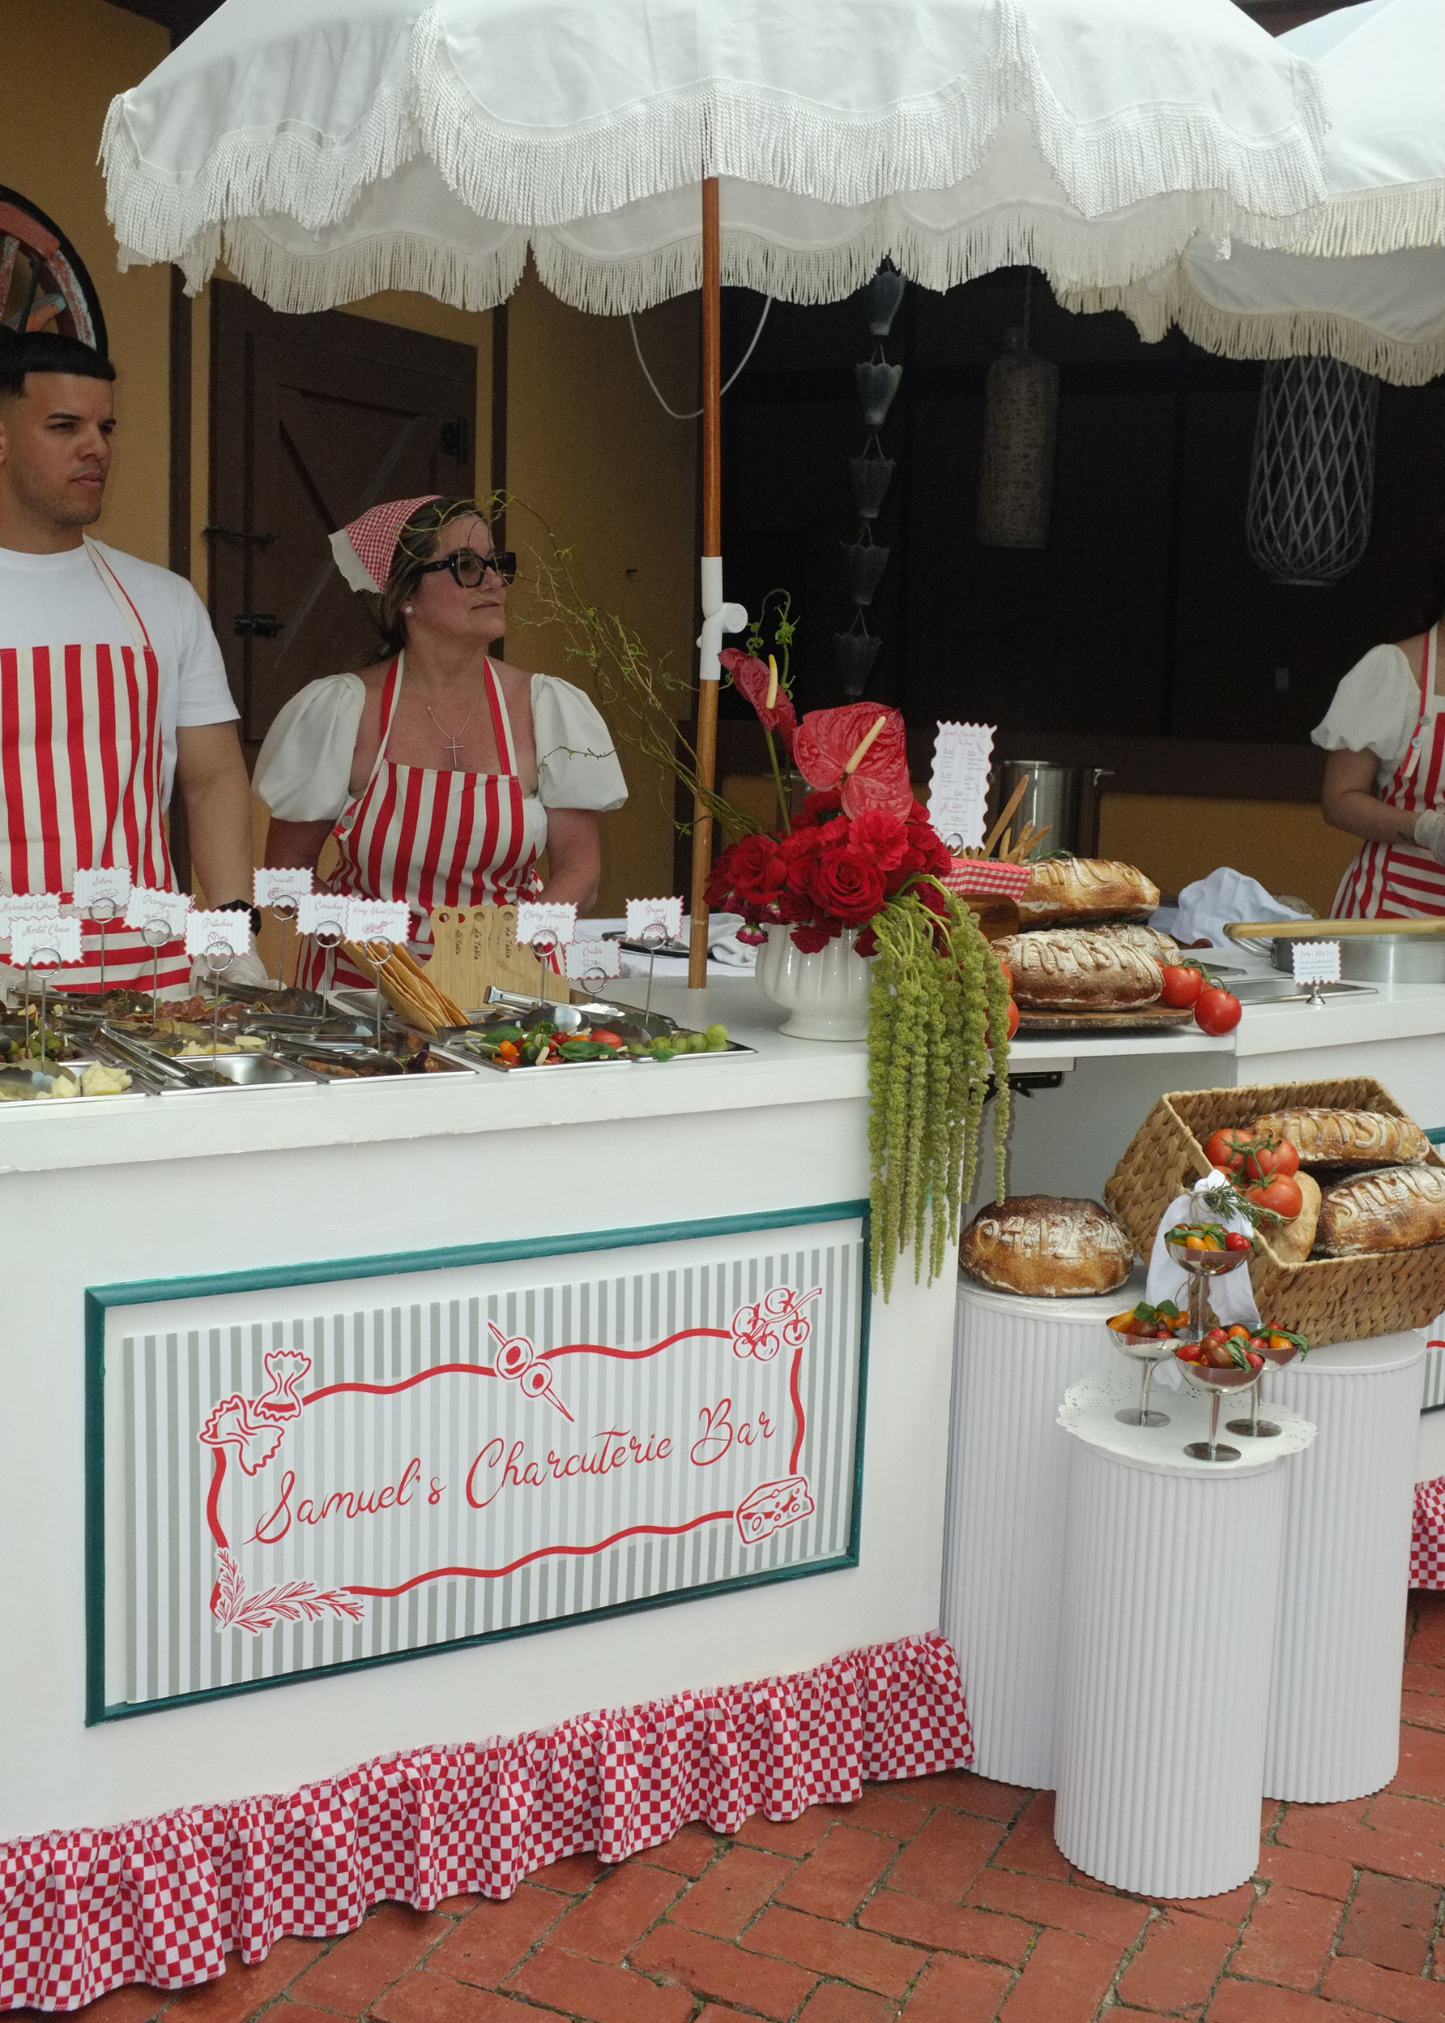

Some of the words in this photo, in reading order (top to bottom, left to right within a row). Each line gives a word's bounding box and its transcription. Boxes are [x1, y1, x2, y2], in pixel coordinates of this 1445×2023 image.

[523, 909, 544, 921] Cherry
[644, 903, 665, 917] Grapes
[21, 924, 47, 937] Merlot
[48, 923, 71, 936] Cheese
[243, 1457, 447, 1545] Samuel's
[466, 1425, 674, 1509] Charcuterie
[690, 1398, 776, 1466] Bar
